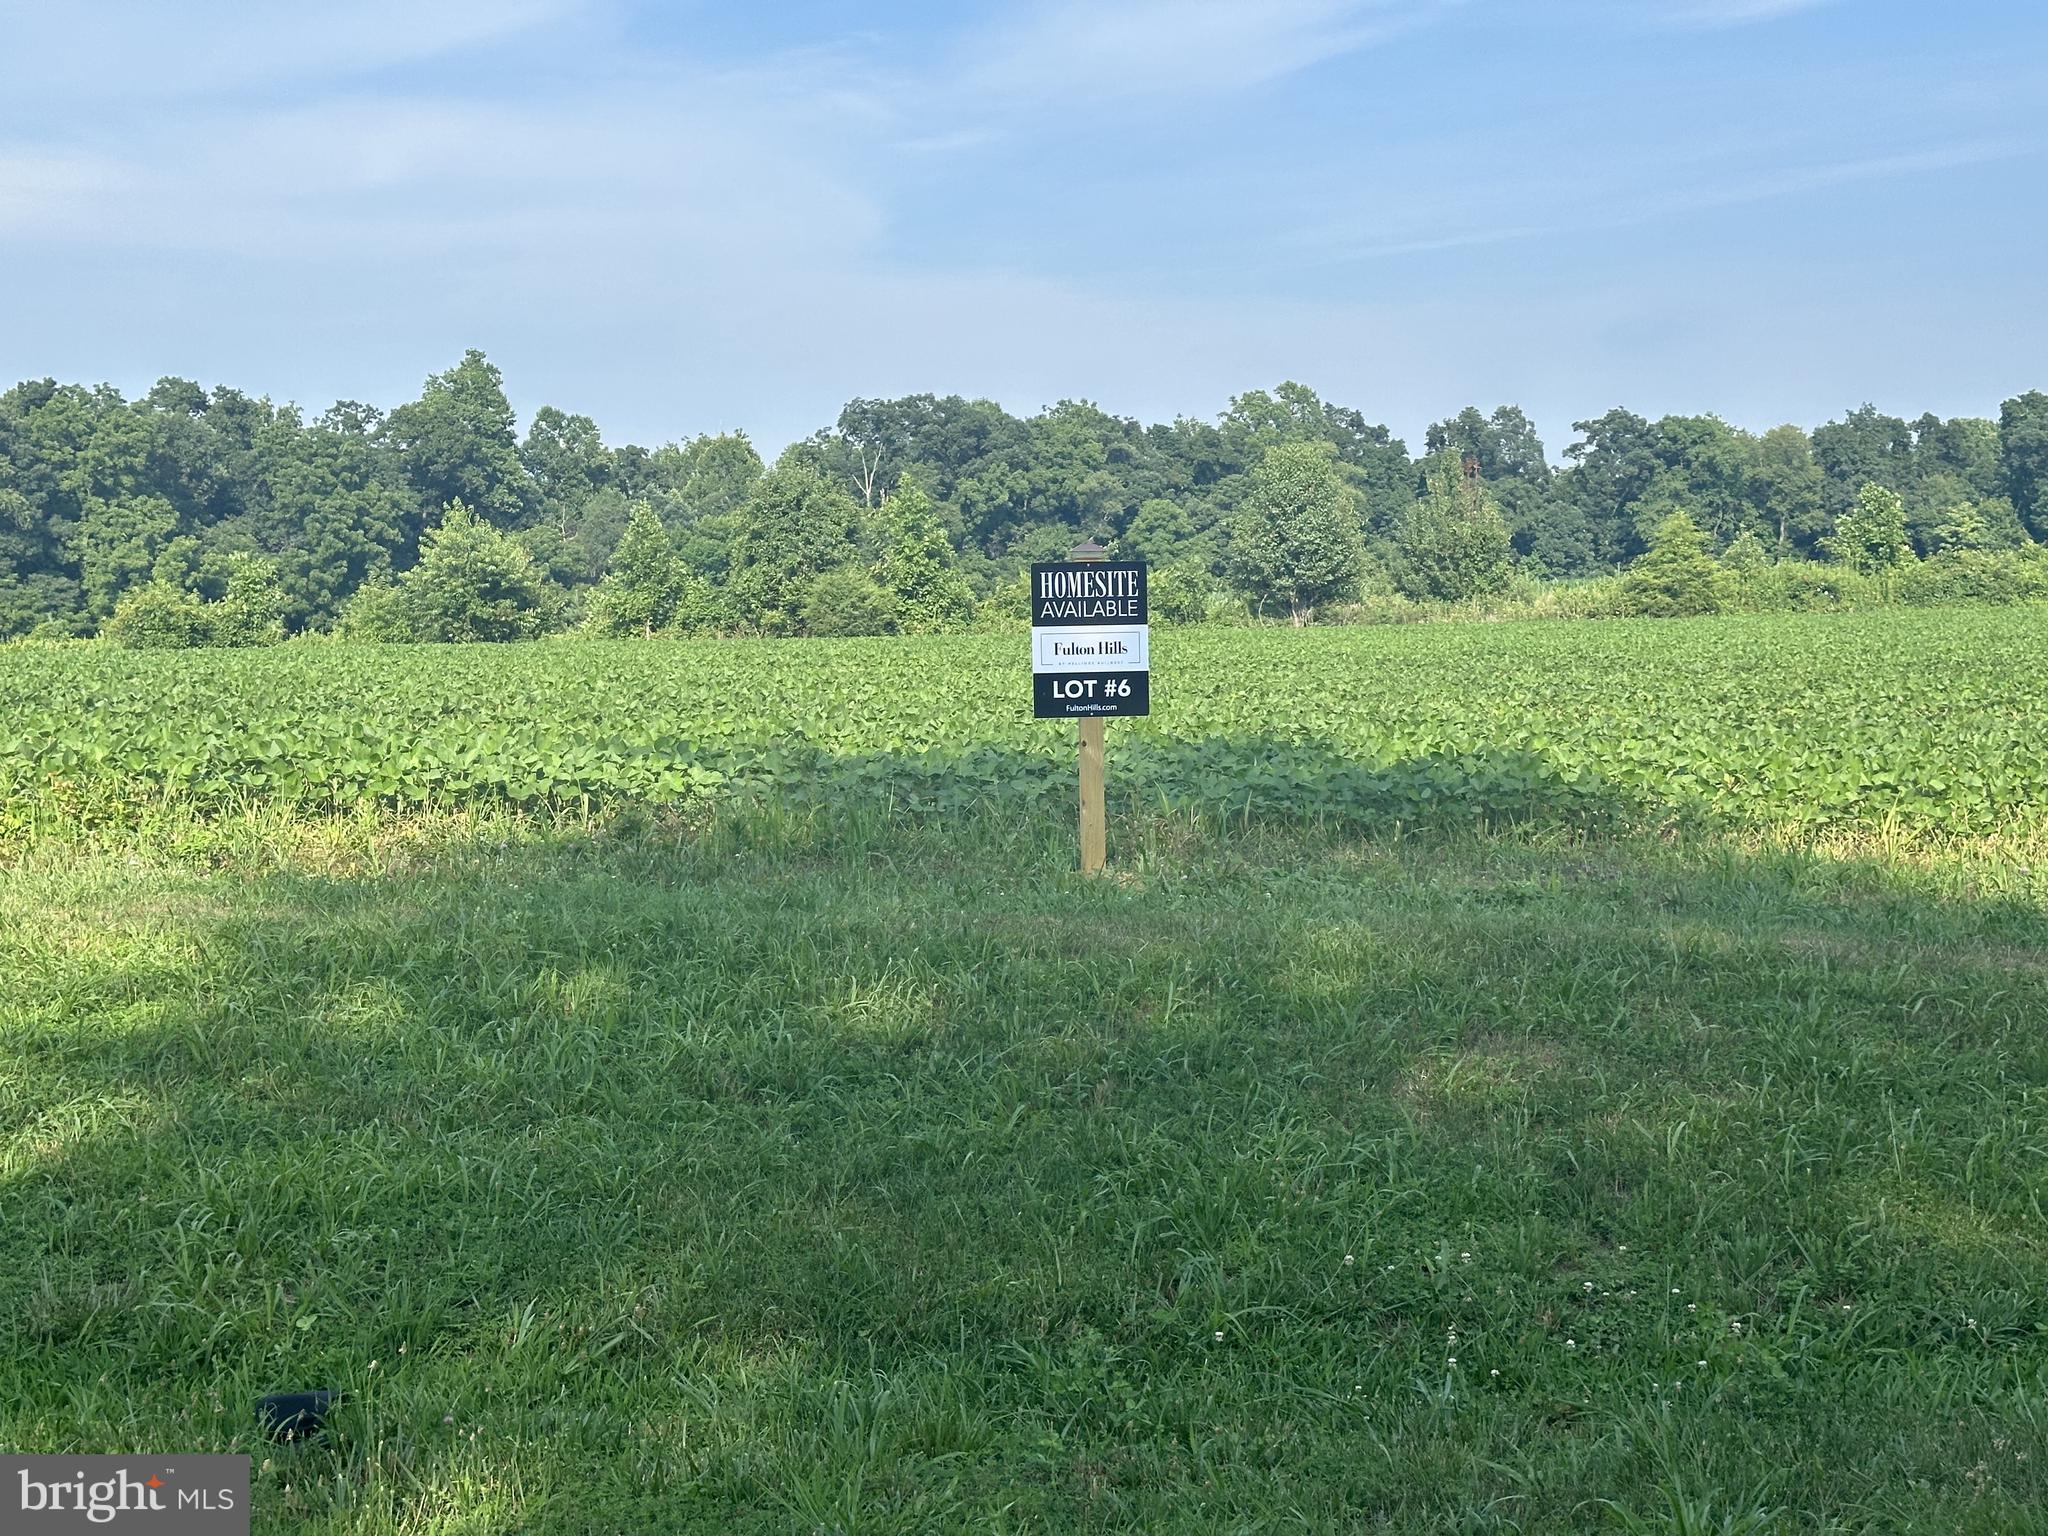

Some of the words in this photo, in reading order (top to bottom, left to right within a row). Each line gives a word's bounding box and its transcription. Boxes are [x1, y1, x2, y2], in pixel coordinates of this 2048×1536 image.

[1040, 571, 1139, 598] HOMESITE
[1040, 599, 1139, 618] AVAILABLE
[1054, 642, 1094, 656] Fulton
[1098, 641, 1128, 655] Hills
[1053, 680, 1097, 699] LOT
[1104, 679, 1131, 697] #6
[1066, 704, 1117, 712] FultonHills.com
